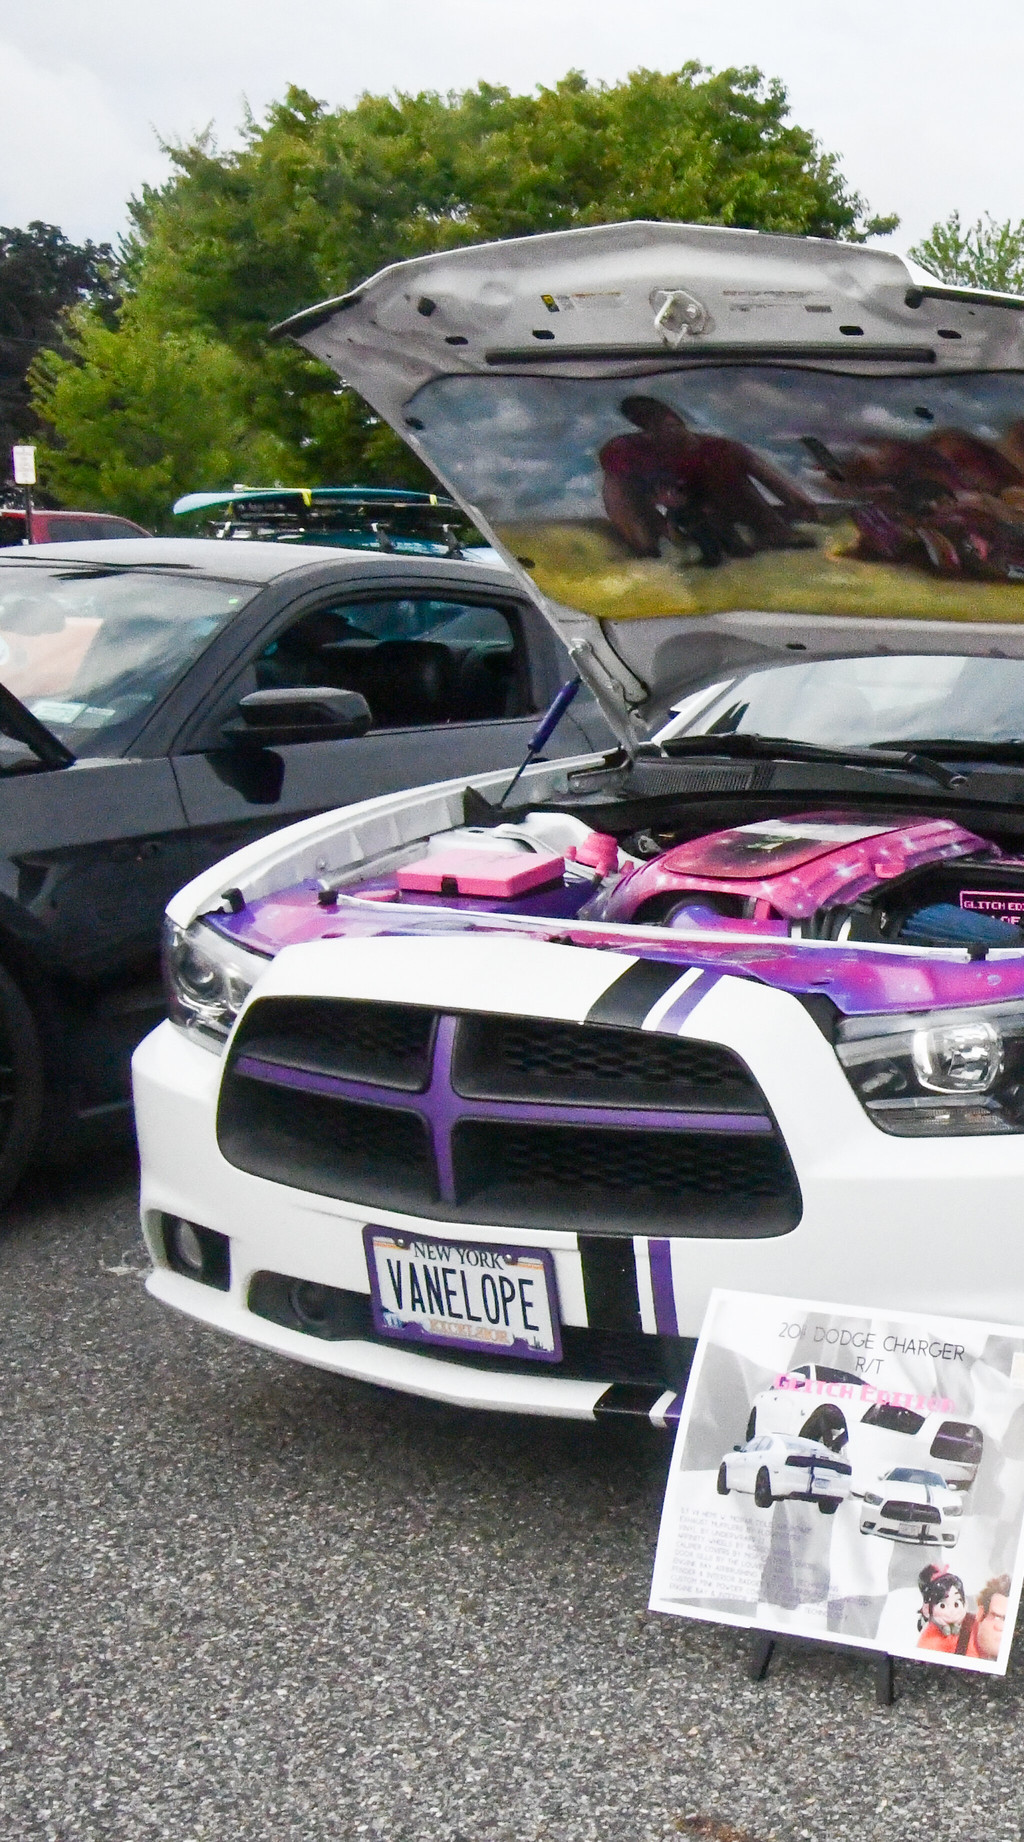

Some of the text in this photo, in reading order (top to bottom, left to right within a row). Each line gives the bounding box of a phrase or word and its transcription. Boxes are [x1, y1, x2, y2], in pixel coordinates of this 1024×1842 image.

[963, 901, 1005, 910] GLITCH
[414, 1242, 504, 1271] NEW YORK
[386, 1258, 540, 1332] VANELOPE
[813, 1326, 876, 1349] DODGE
[883, 1335, 965, 1361] CHARGER
[855, 1356, 884, 1374] R/T
